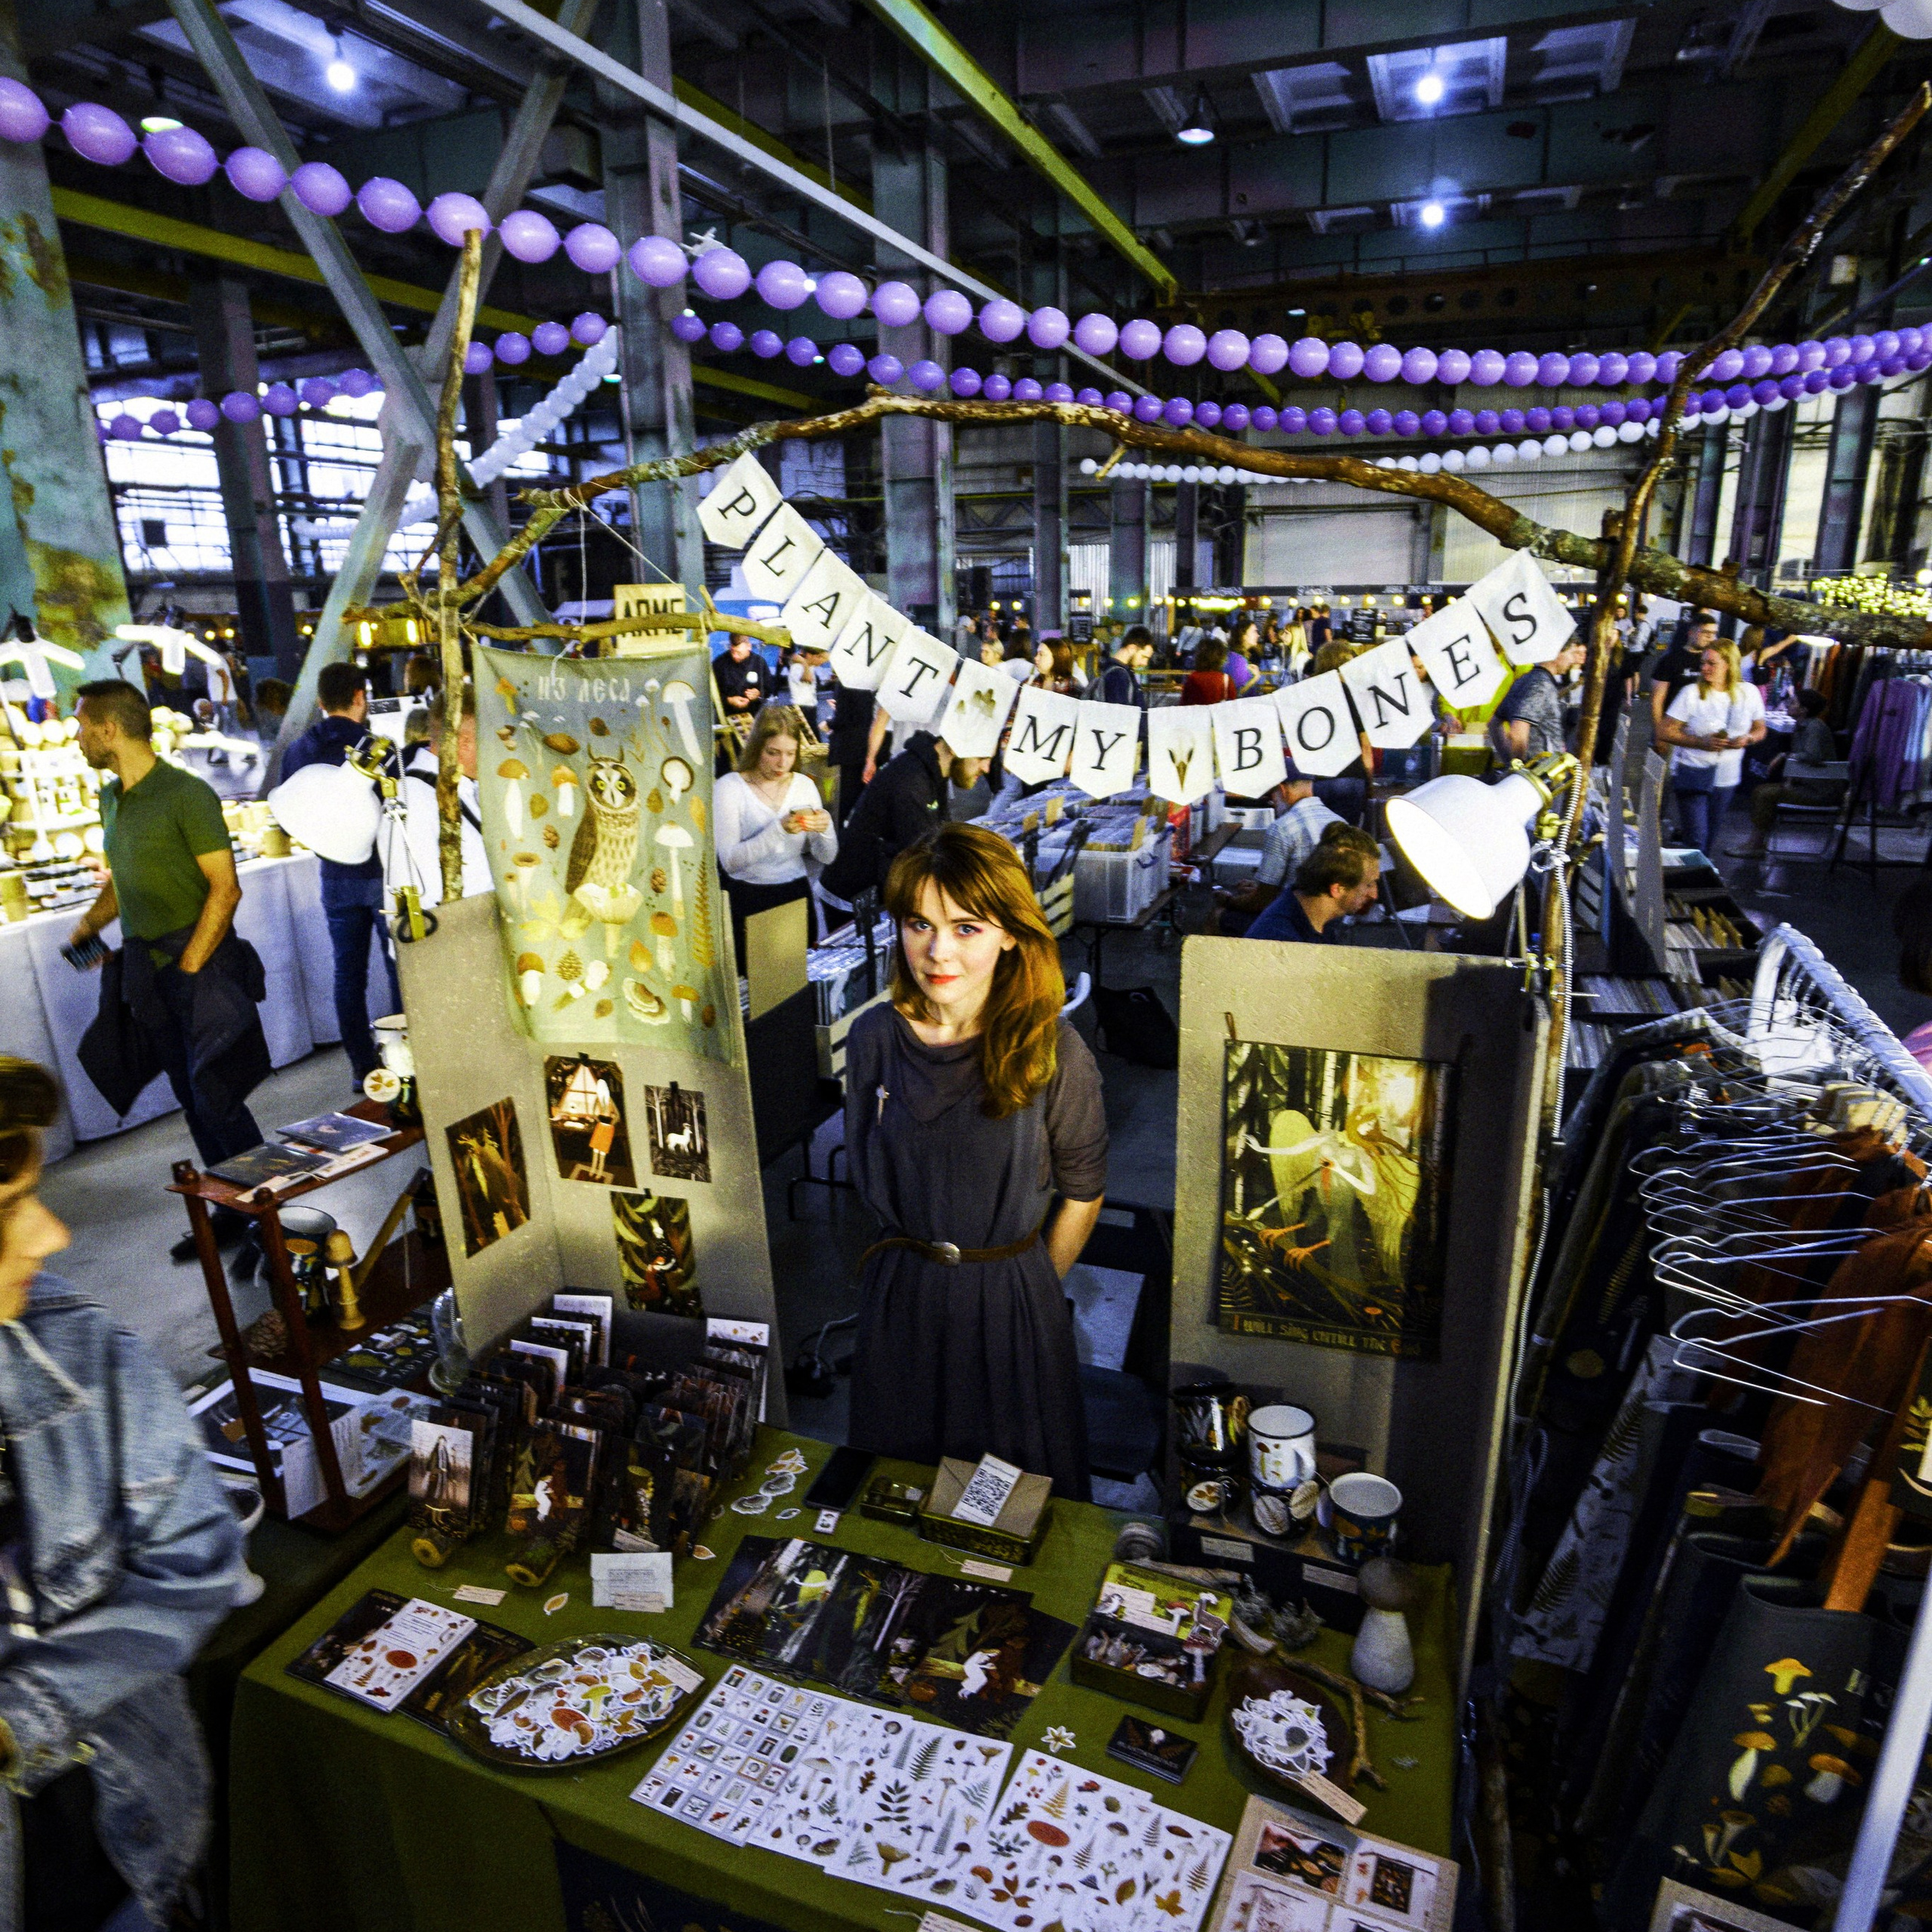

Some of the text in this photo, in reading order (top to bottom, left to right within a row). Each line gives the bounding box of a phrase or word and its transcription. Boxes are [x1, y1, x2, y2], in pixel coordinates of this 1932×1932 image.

[718, 486, 1537, 771] PLANT MY BONES
